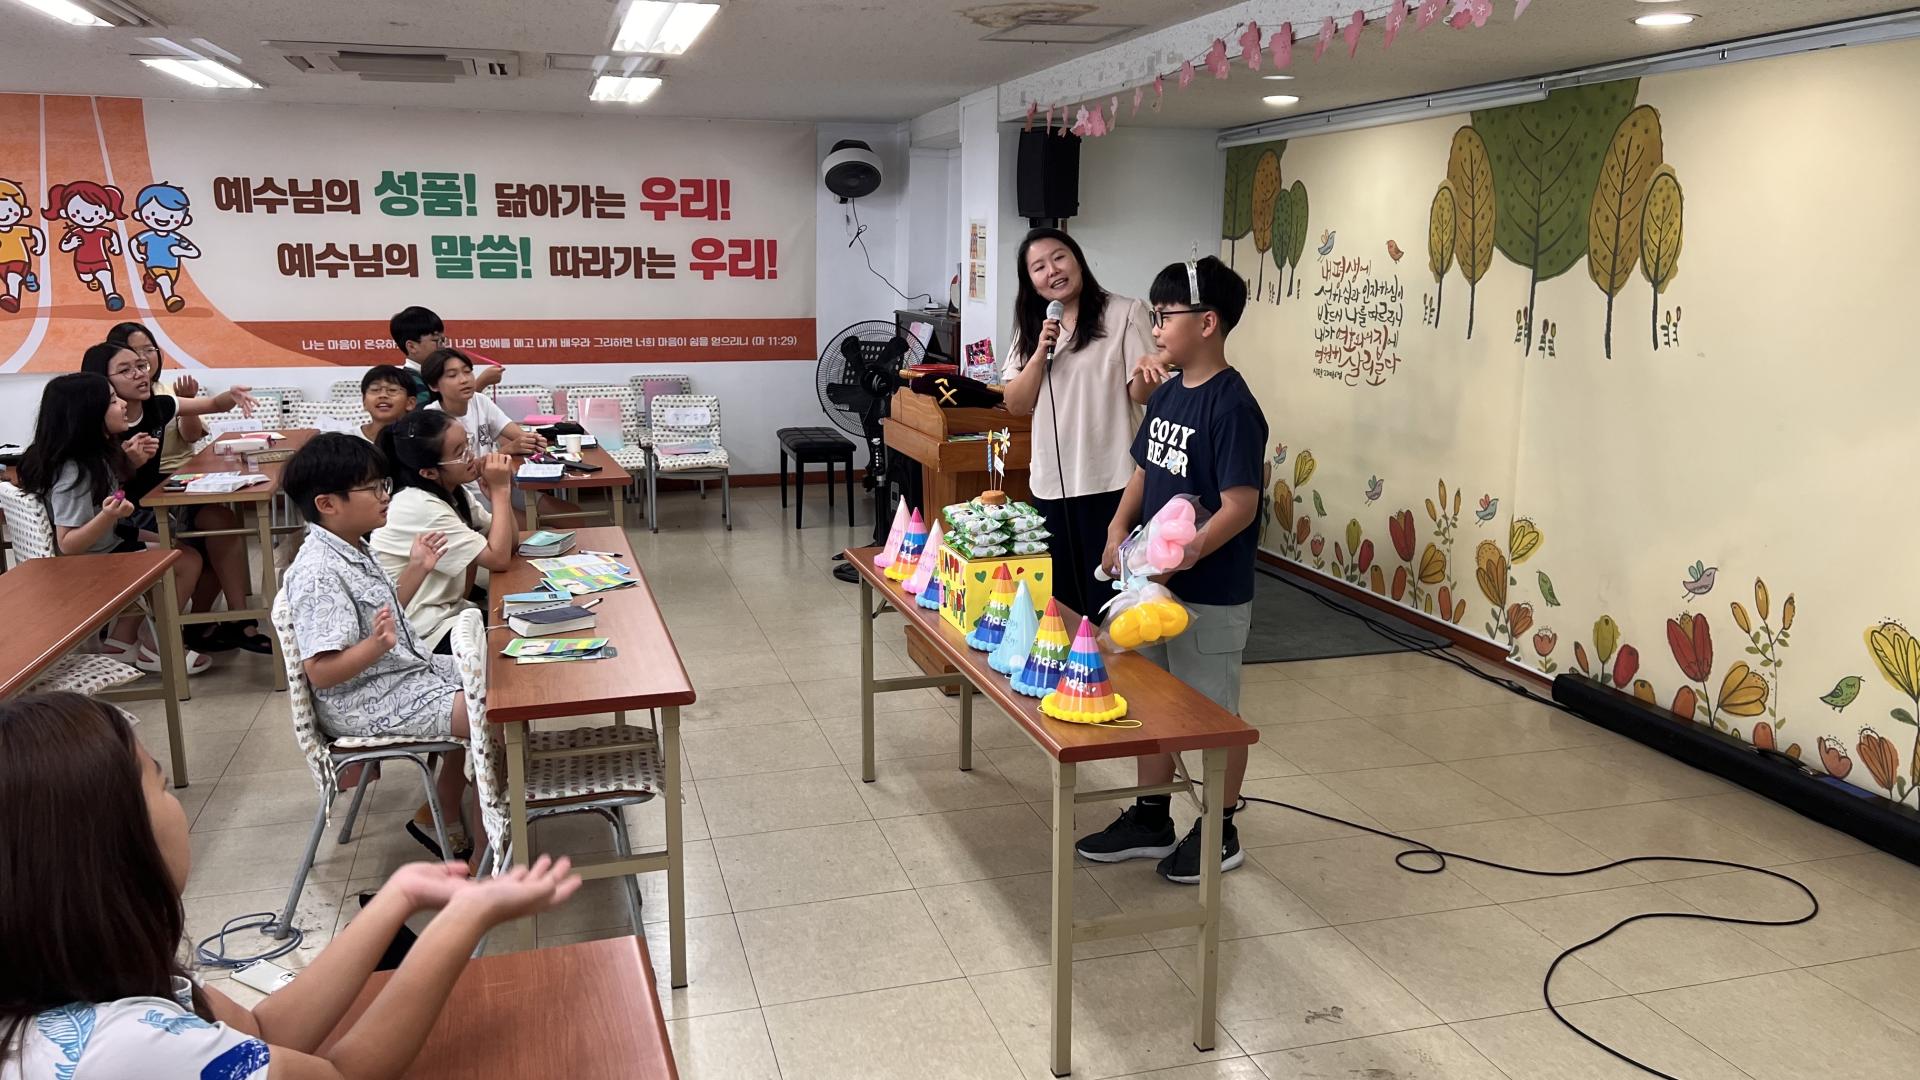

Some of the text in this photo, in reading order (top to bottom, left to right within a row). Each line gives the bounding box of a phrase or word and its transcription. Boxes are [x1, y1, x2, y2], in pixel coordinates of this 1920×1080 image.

[213, 170, 731, 221] 예수님의 성품! 닮아가는 우리!
[277, 234, 778, 280] 예수님의 말씀! 따라가는 우리!
[302, 340, 399, 350] 나는 마음이 온유하
[455, 338, 476, 349] 나의
[479, 338, 511, 349] 멍에를
[514, 338, 534, 348] 메고
[537, 338, 557, 348] 내게
[560, 338, 591, 348] 배우라
[594, 337, 633, 348] 그리하면
[636, 337, 655, 347] 너희
[658, 337, 687, 347] 마음이
[689, 337, 709, 347] 쉼을
[711, 336, 749, 347] 얻으리니
[752, 336, 765, 347] (마
[768, 336, 797, 346] 11:29)
[1149, 416, 1196, 450] COZY
[1146, 438, 1189, 478] BEAR
